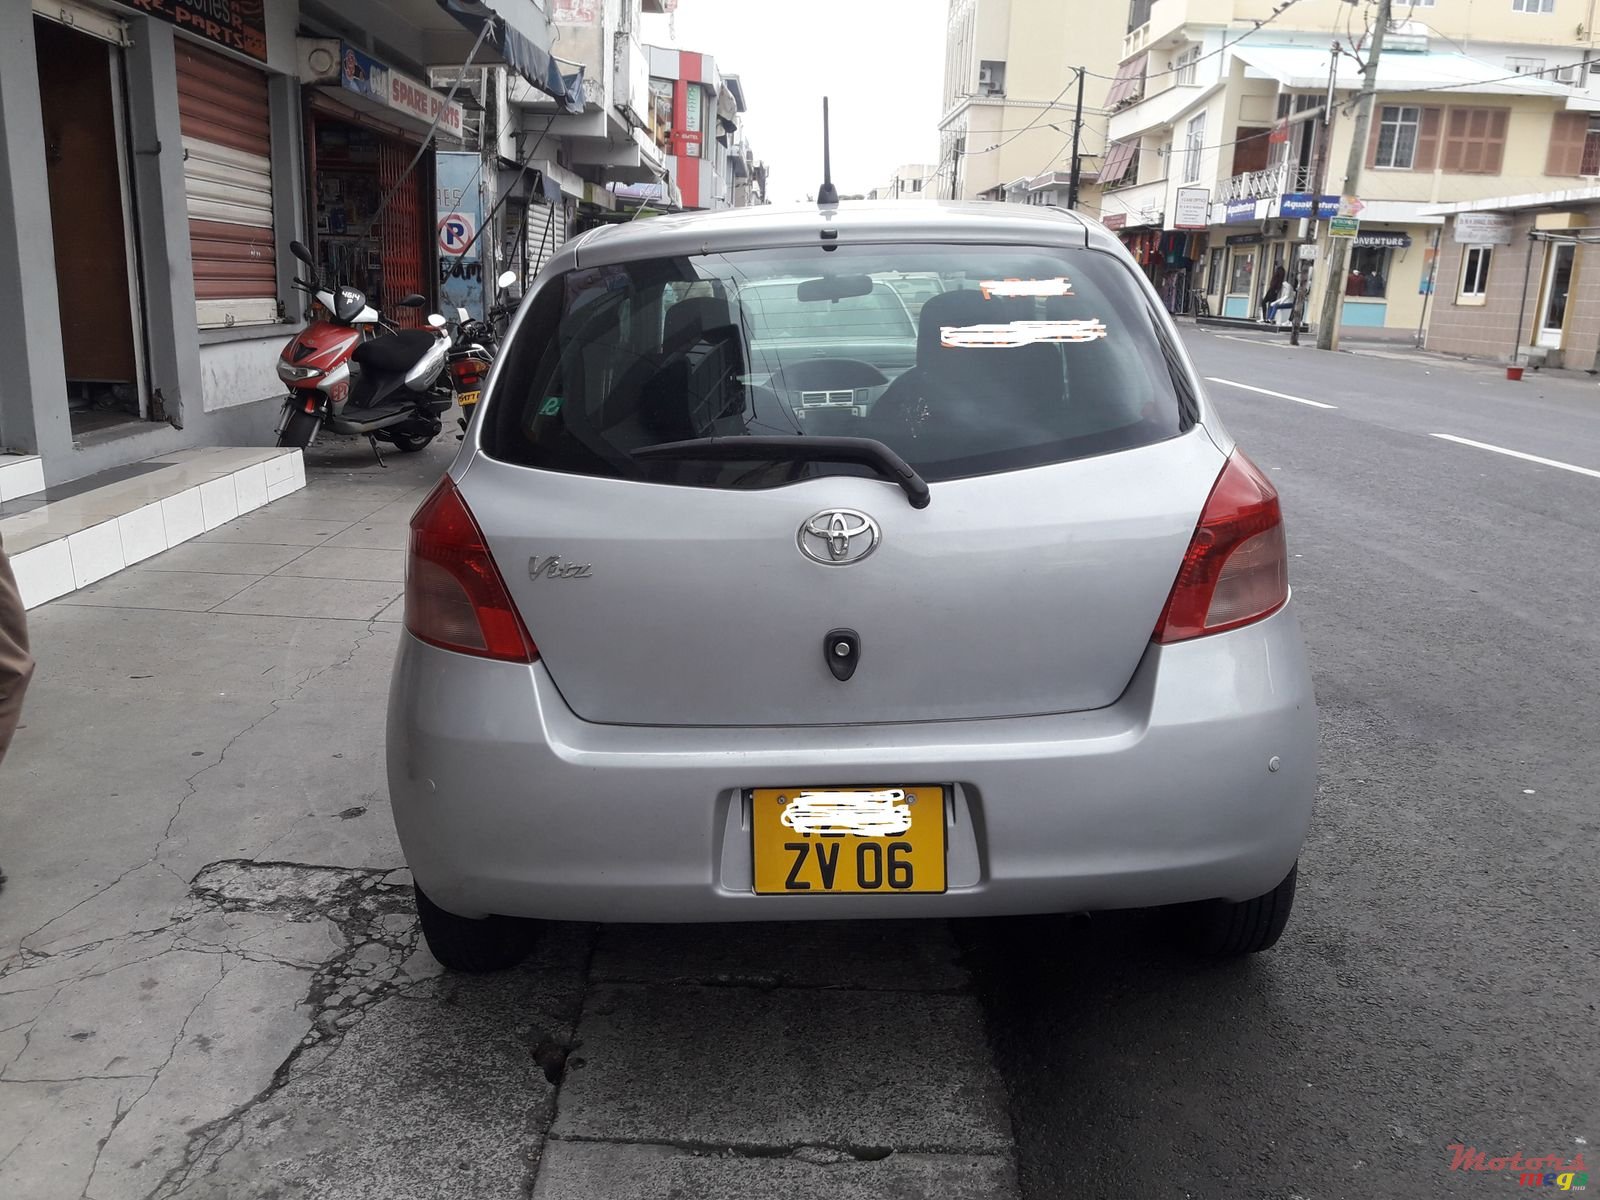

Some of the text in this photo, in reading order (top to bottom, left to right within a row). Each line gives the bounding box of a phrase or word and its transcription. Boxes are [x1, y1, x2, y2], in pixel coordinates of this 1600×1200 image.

[392, 78, 428, 114] SPARE
[528, 555, 593, 581] Vitz
[784, 842, 914, 890] ZV 06
